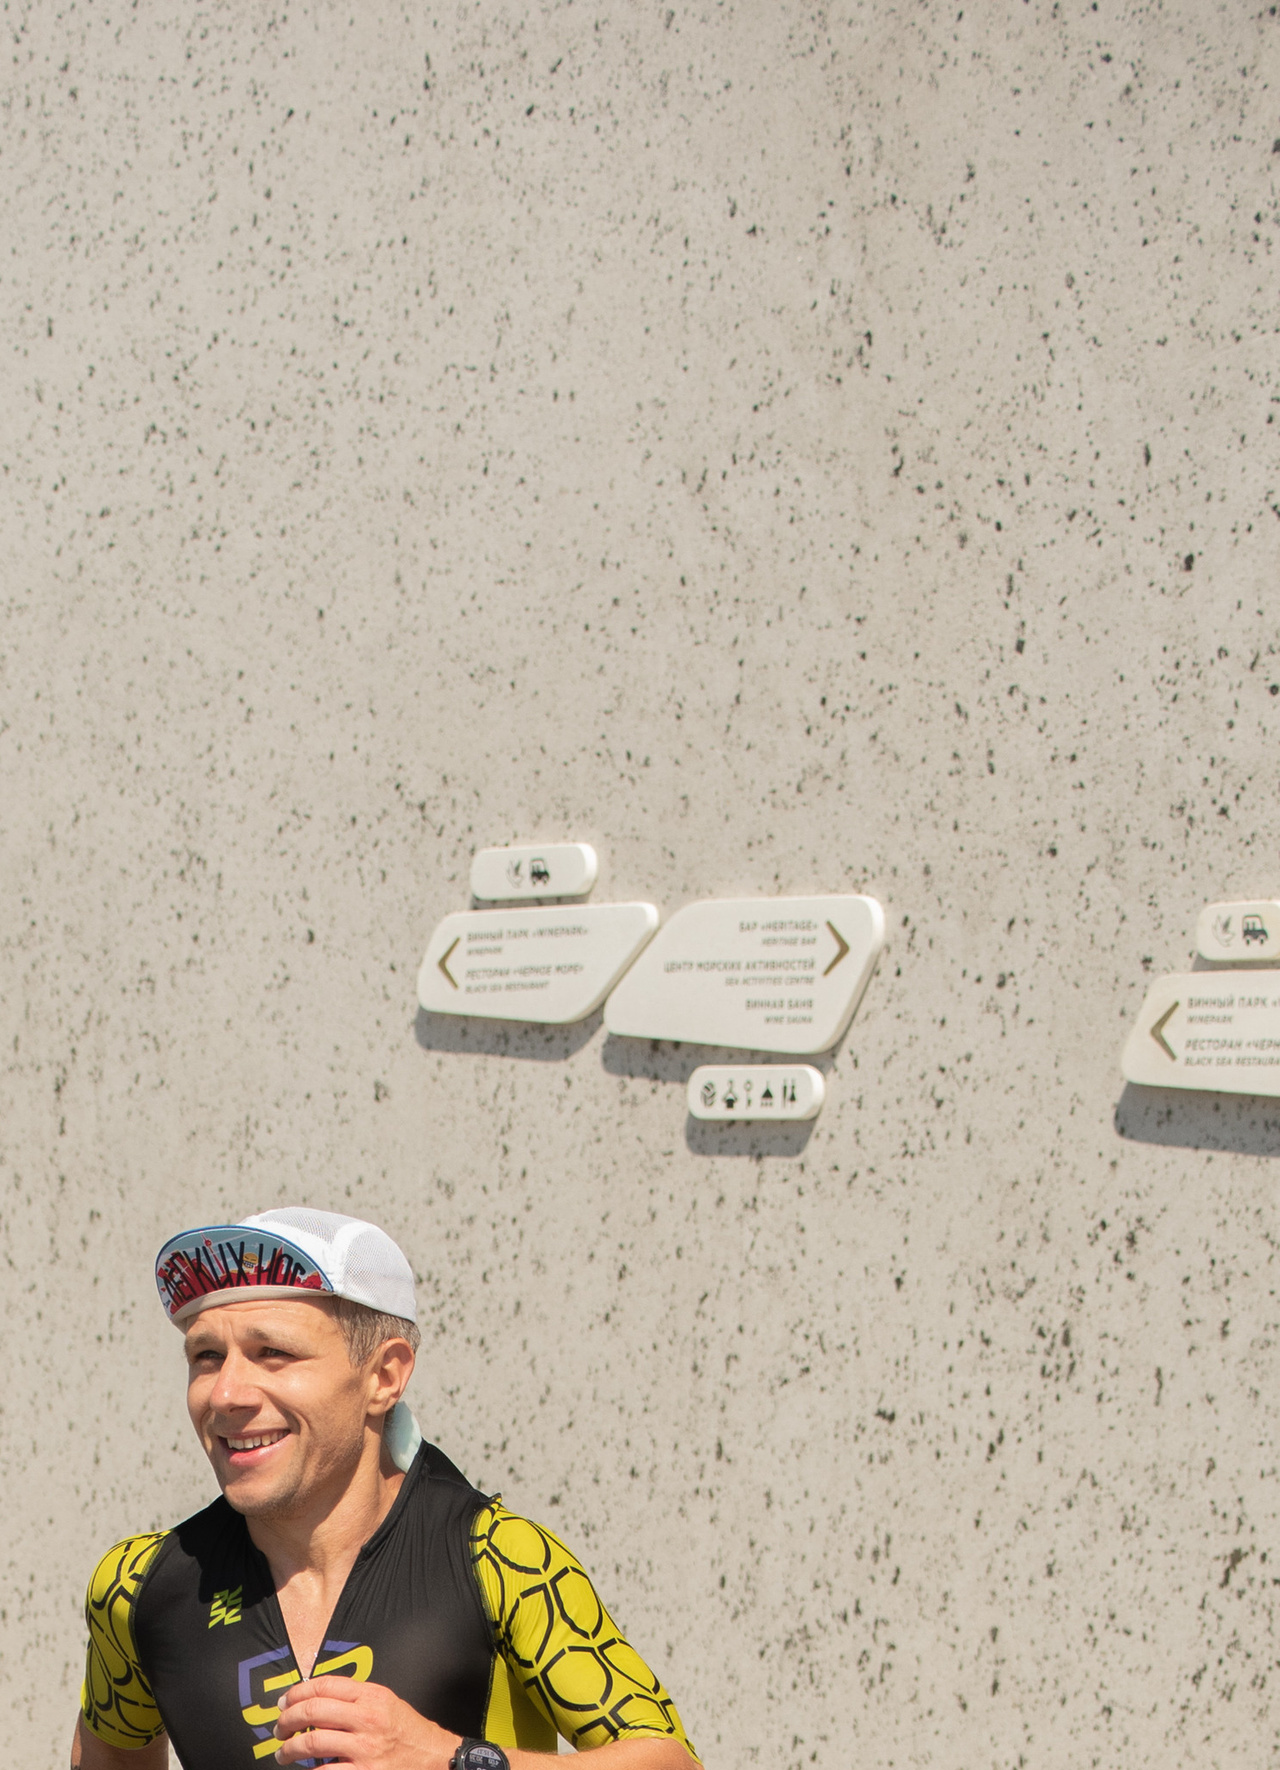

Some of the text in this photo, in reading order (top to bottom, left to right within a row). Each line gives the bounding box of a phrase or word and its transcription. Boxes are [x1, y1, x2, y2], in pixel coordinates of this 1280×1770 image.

[739, 921, 758, 932] БАР
[664, 956, 816, 973] ЦЕНТР МОРСКИХ АКТИВНОСТЕЙ
[1188, 994, 1234, 1009] ВИННЫЙ
[1238, 996, 1267, 1008] ПАРК
[1187, 1015, 1232, 1025] WINEPARK
[1185, 1038, 1242, 1051] РЕСТОРАН
[1184, 1056, 1213, 1067] BLACK
[1215, 1056, 1232, 1067] SEA
